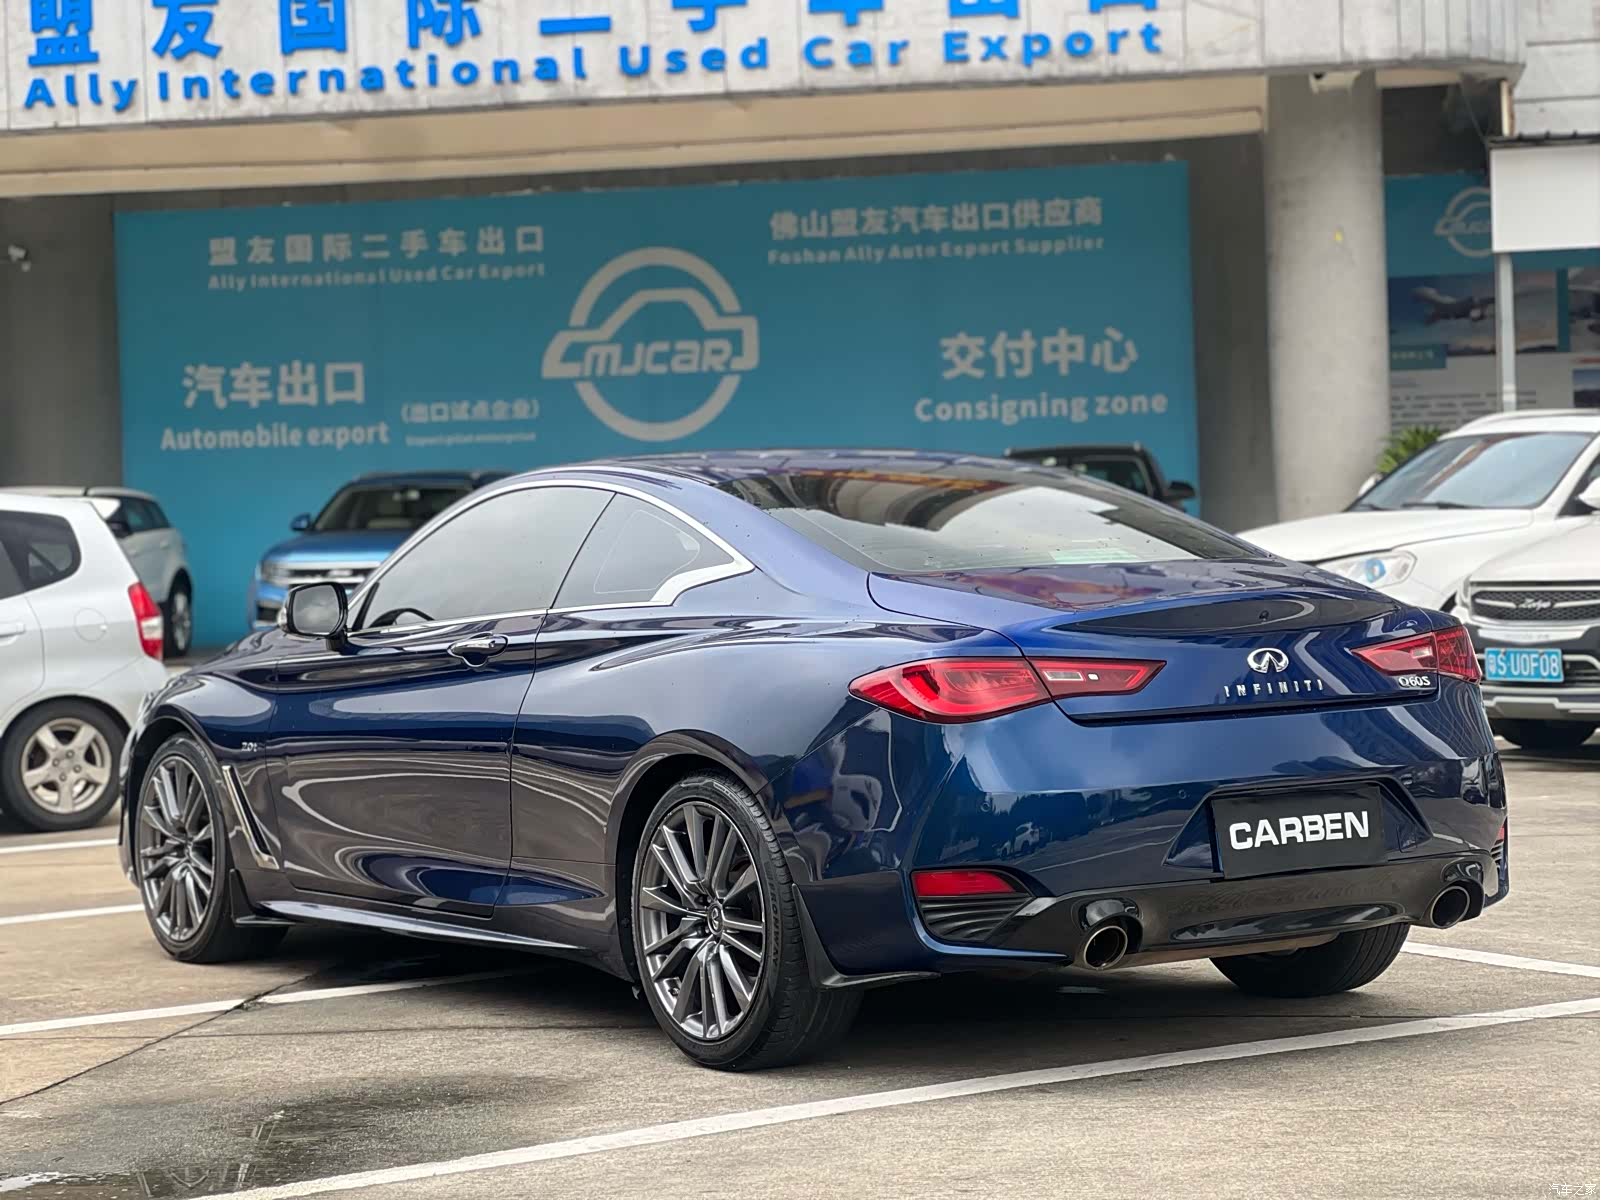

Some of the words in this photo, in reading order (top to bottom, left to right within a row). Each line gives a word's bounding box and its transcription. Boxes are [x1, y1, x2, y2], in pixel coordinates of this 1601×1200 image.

[24, 73, 137, 112] Ally
[158, 47, 587, 101] International
[619, 38, 768, 77] Used
[803, 35, 909, 69] Car
[943, 22, 1162, 67] Export
[208, 225, 544, 266] 盟友国际二手车出口
[767, 249, 841, 265] Foshan
[844, 245, 885, 264] Ally
[888, 243, 936, 259] Auto
[941, 240, 1009, 259] Export
[1015, 234, 1104, 255] Supplier
[208, 273, 247, 291] Ally
[251, 268, 385, 288] International
[389, 265, 437, 283] Used
[441, 263, 473, 281] Car
[479, 262, 545, 281] Export
[939, 326, 1138, 379] 交付中心
[182, 359, 365, 409] 汽车出口
[914, 391, 1089, 426] Consigning
[1095, 393, 1169, 415] zone
[160, 421, 302, 451] Automobile
[307, 420, 391, 451] export
[1223, 678, 1324, 698] INFINITI
[1398, 675, 1431, 687] Q60S
[1229, 810, 1369, 850] CARBEN
